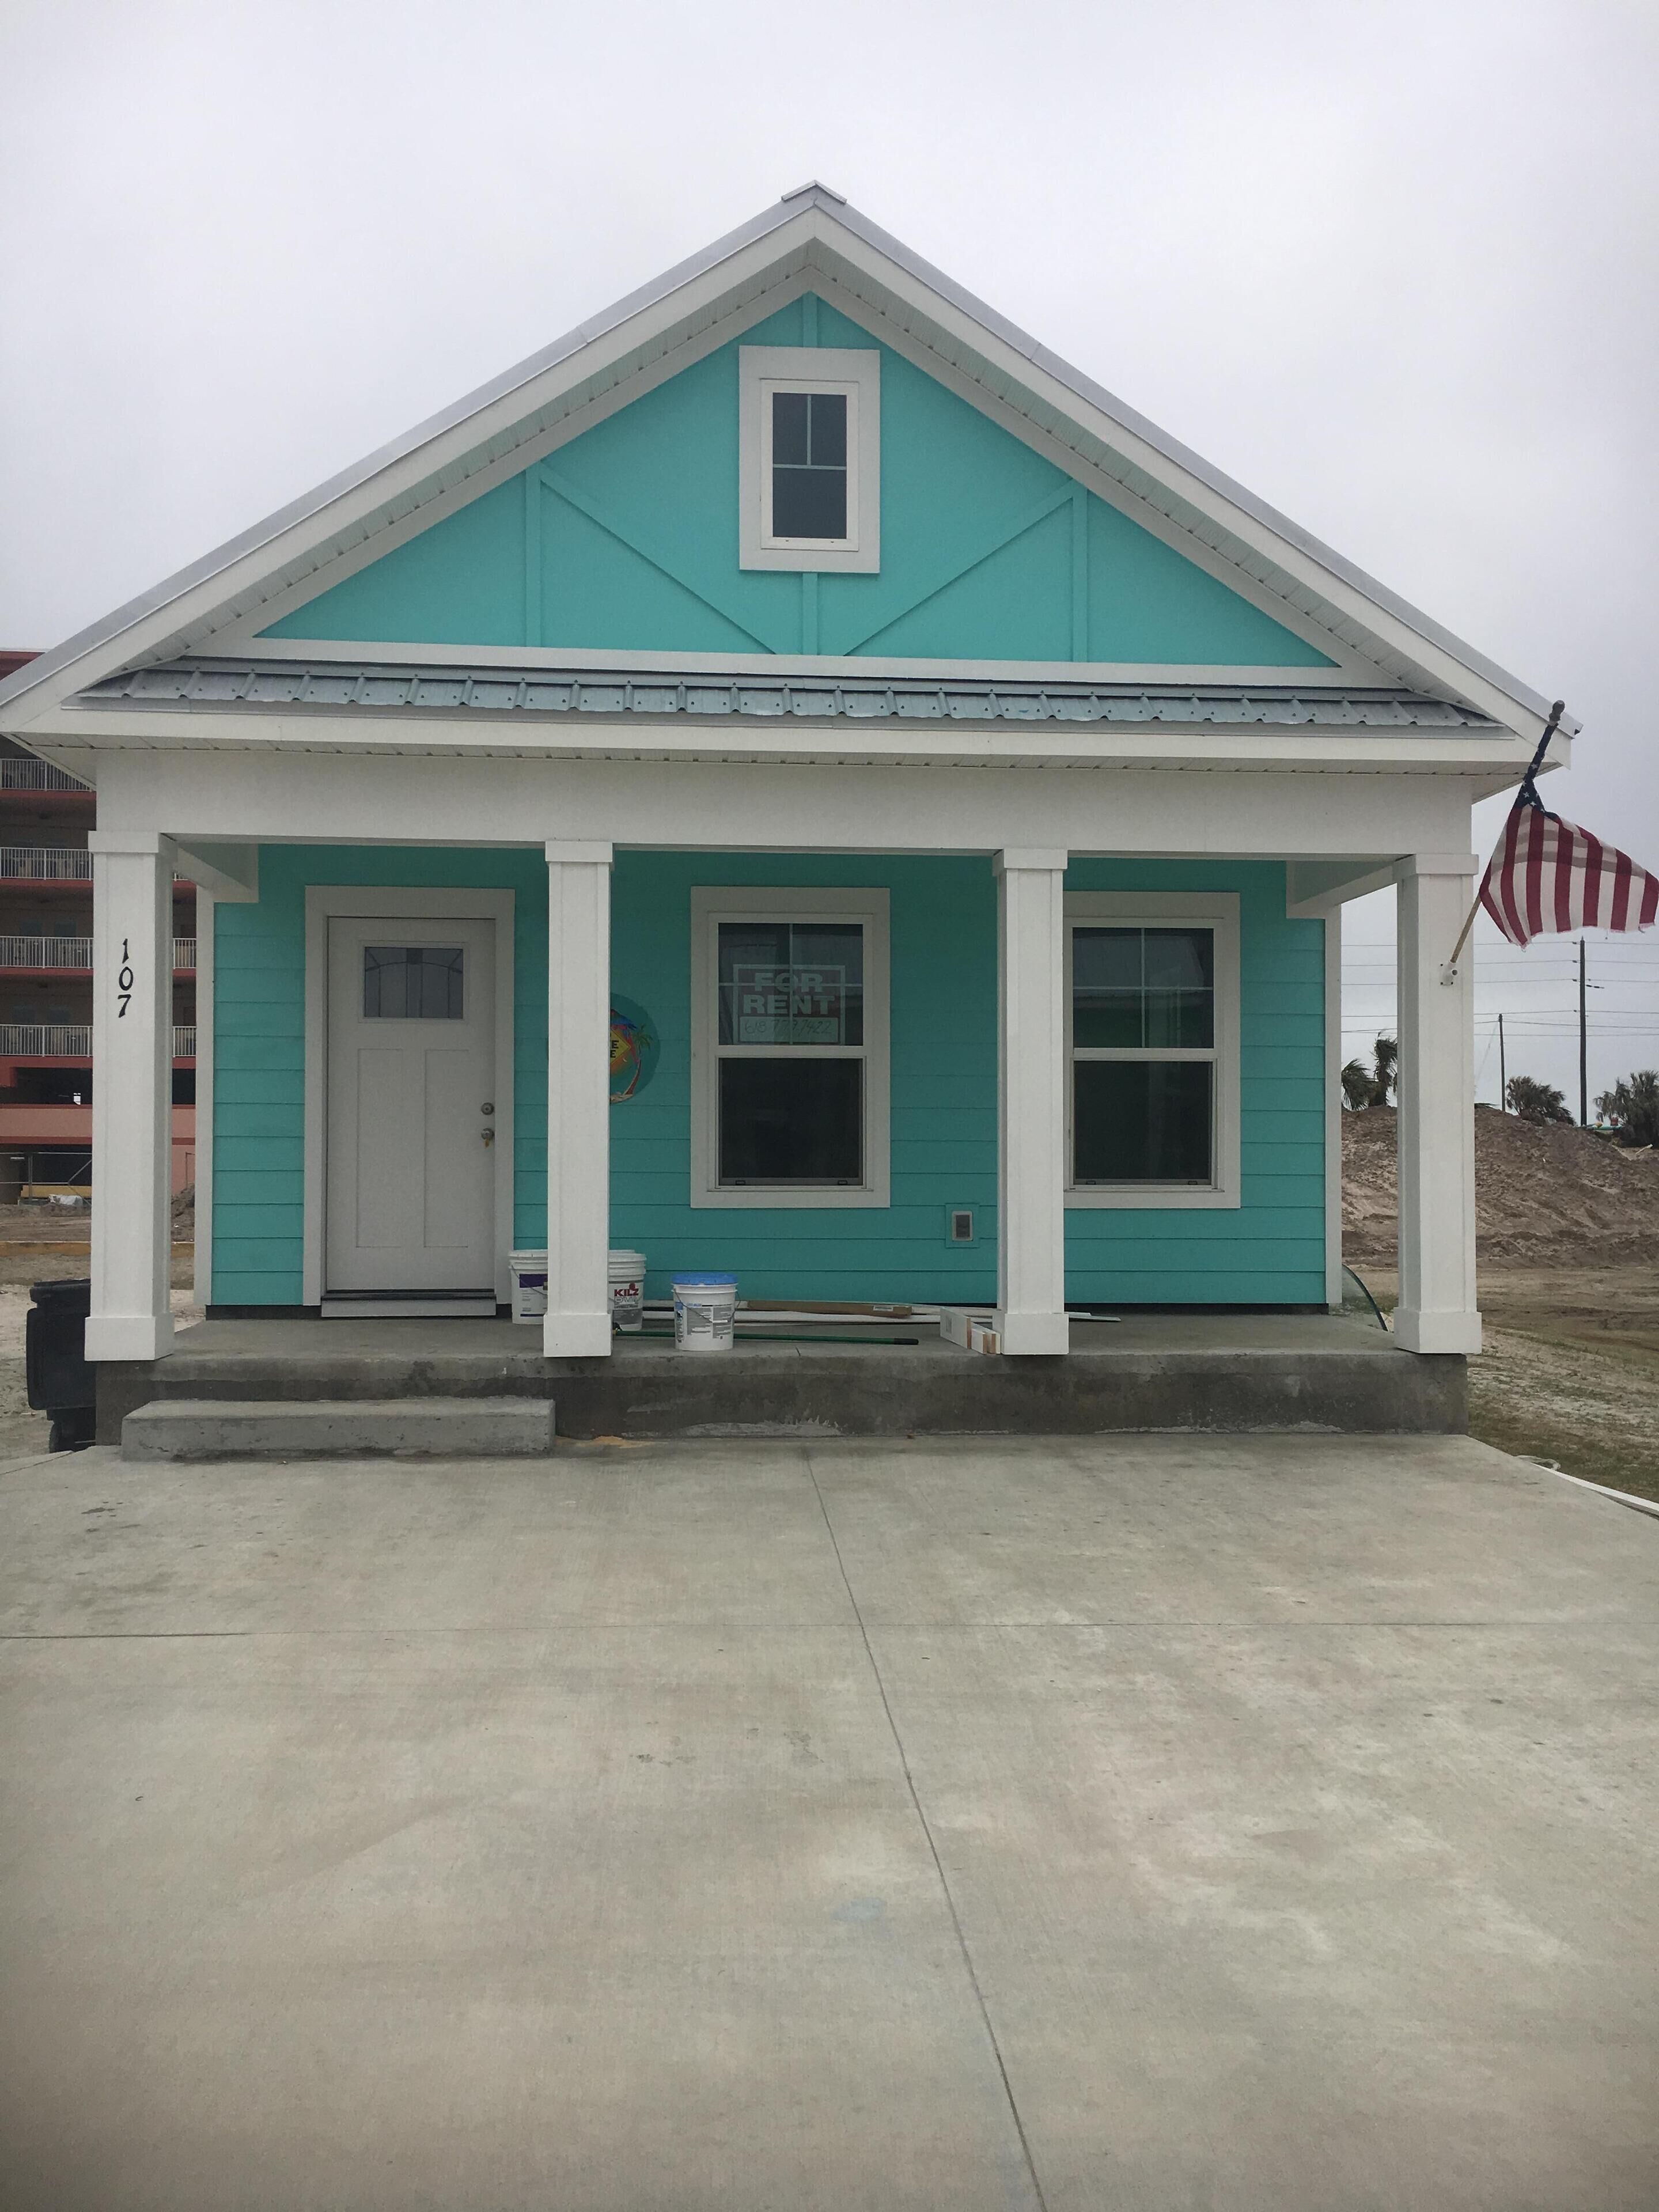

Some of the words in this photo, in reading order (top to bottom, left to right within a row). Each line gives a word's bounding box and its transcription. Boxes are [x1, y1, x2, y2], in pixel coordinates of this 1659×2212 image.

[118, 938, 134, 1018] 107
[754, 973, 823, 993] FOR
[743, 995, 835, 1014] RENT
[614, 1288, 639, 1296] KILZ
